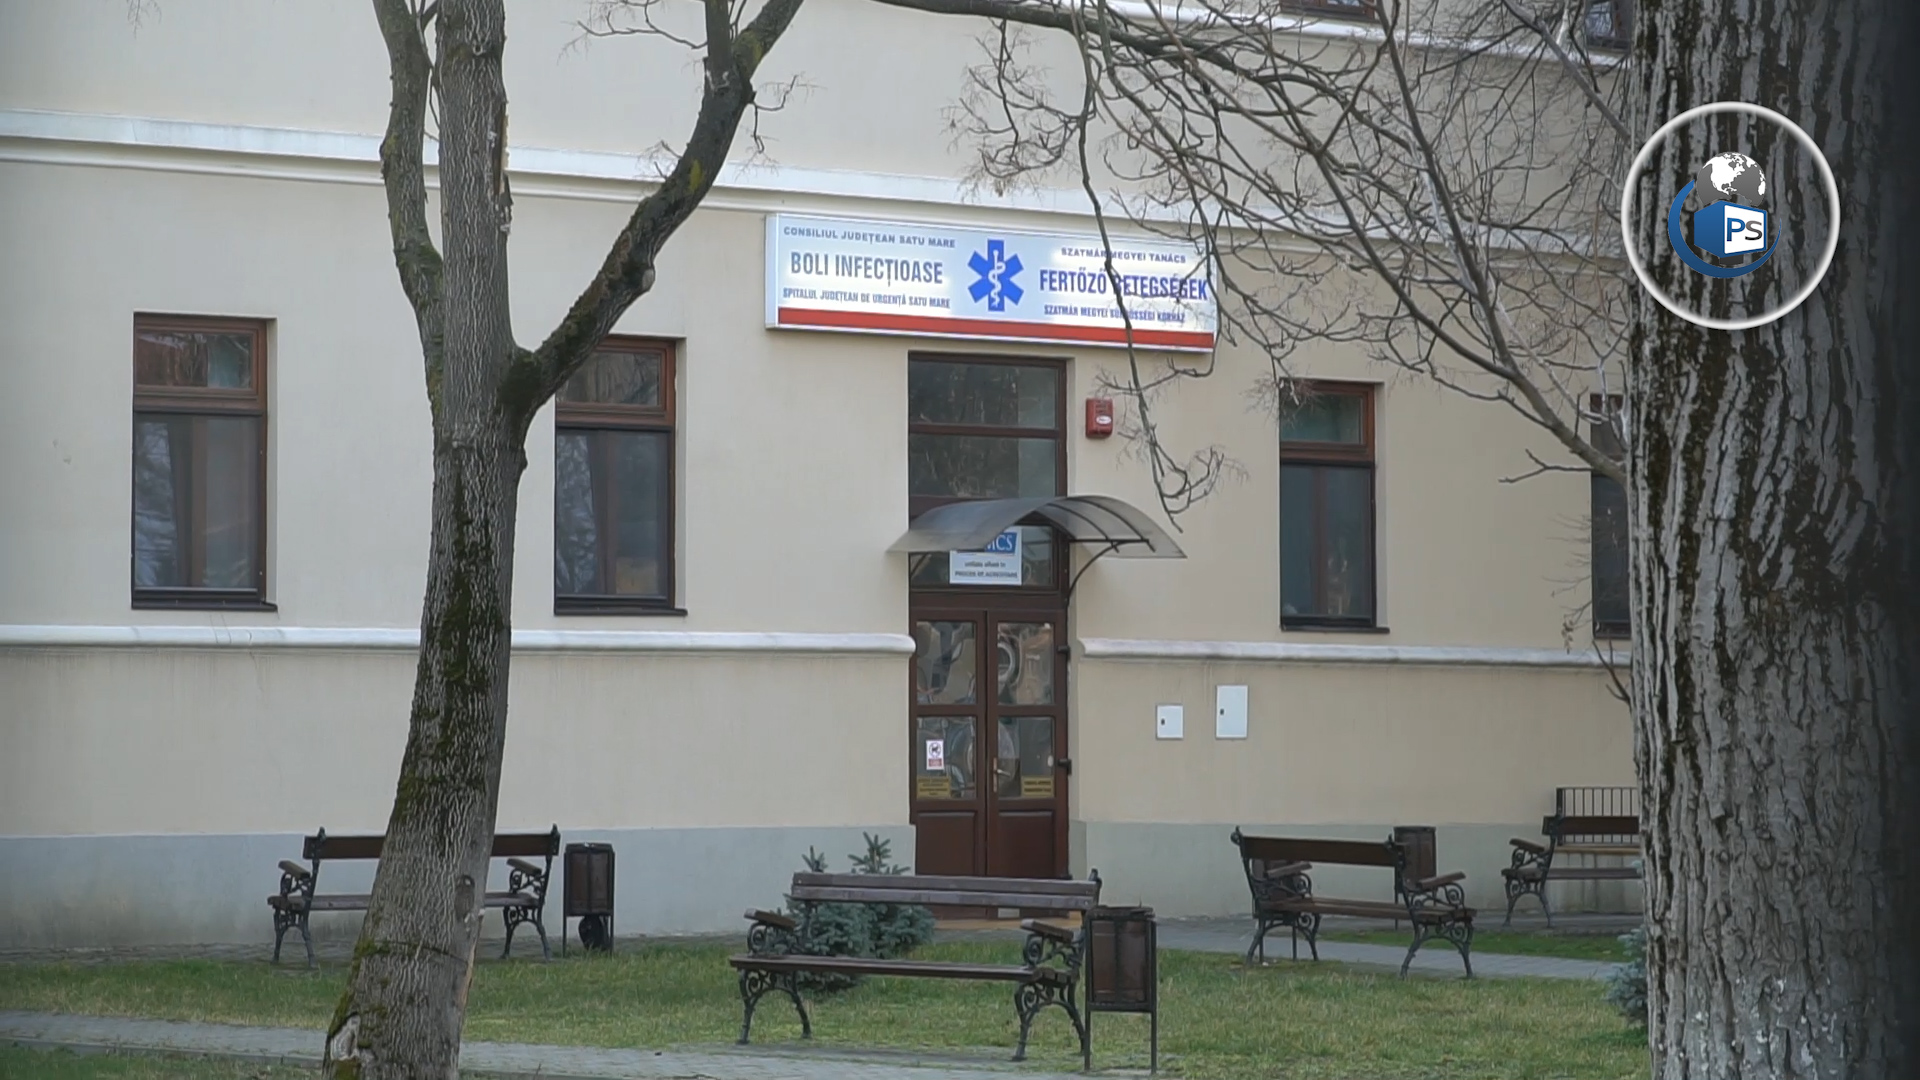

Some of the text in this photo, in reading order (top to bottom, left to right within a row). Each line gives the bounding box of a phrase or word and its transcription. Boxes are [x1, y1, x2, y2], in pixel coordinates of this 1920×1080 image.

[783, 226, 956, 249] CONSILIUL JUDEȚEAN SATU MARE
[790, 251, 943, 287] BOLI INFECȚIOASE
[1149, 252, 1187, 264] TANÁCS
[1039, 267, 1107, 295] FERTŐZŐ
[783, 287, 818, 300] SPITALUL
[860, 293, 871, 304] DE
[908, 296, 928, 307] SATU
[929, 297, 951, 309] MARE
[1044, 304, 1079, 317] SZATMÁR
[1080, 306, 1109, 318] MEGYEI
